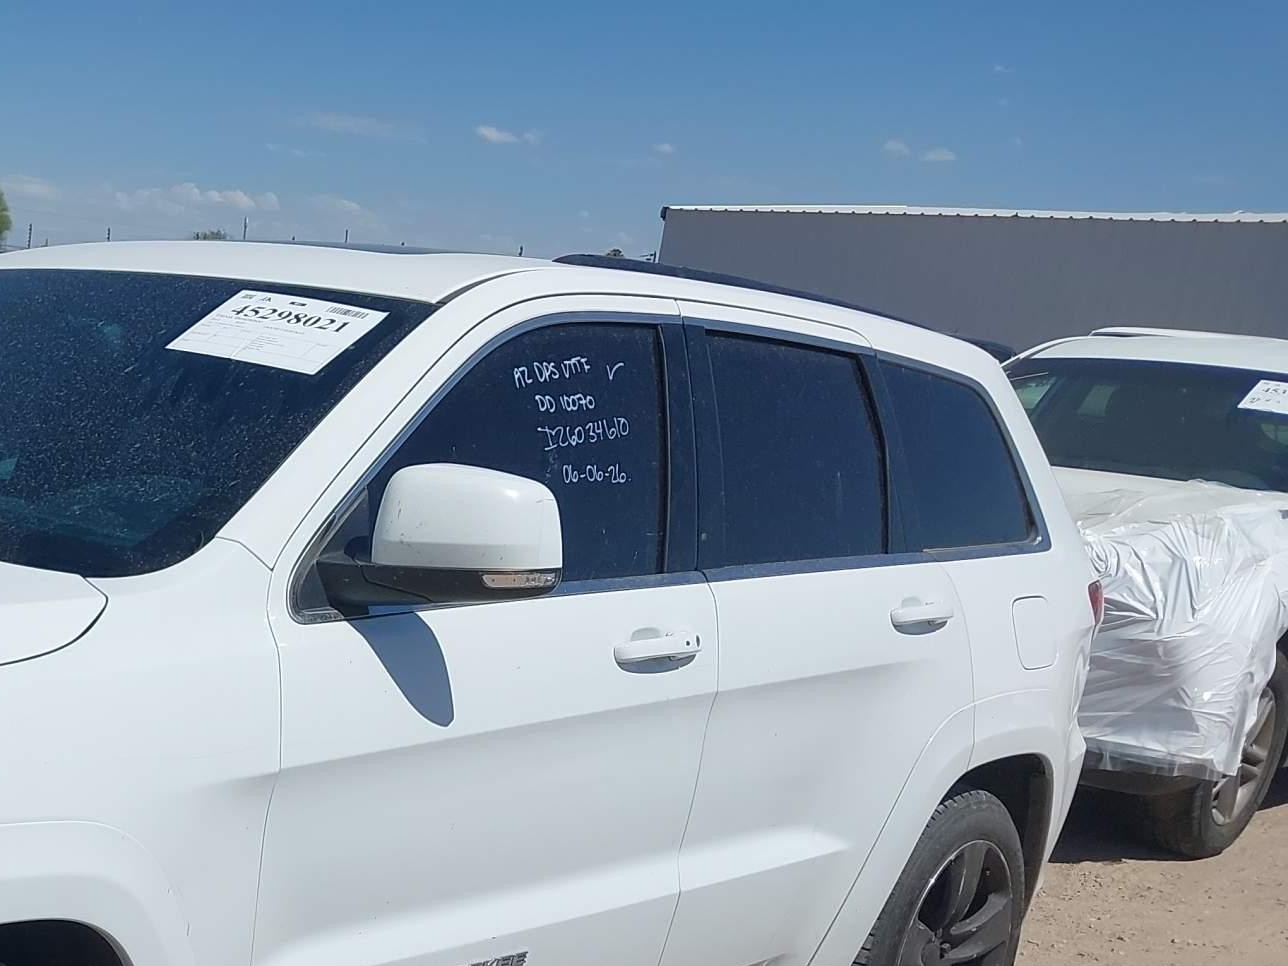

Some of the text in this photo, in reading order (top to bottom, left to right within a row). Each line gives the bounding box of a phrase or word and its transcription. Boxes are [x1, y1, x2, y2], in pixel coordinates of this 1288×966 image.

[230, 304, 351, 333] 45298021
[513, 366, 533, 389] AZ
[533, 361, 560, 382] DPS
[535, 394, 555, 412] DD
